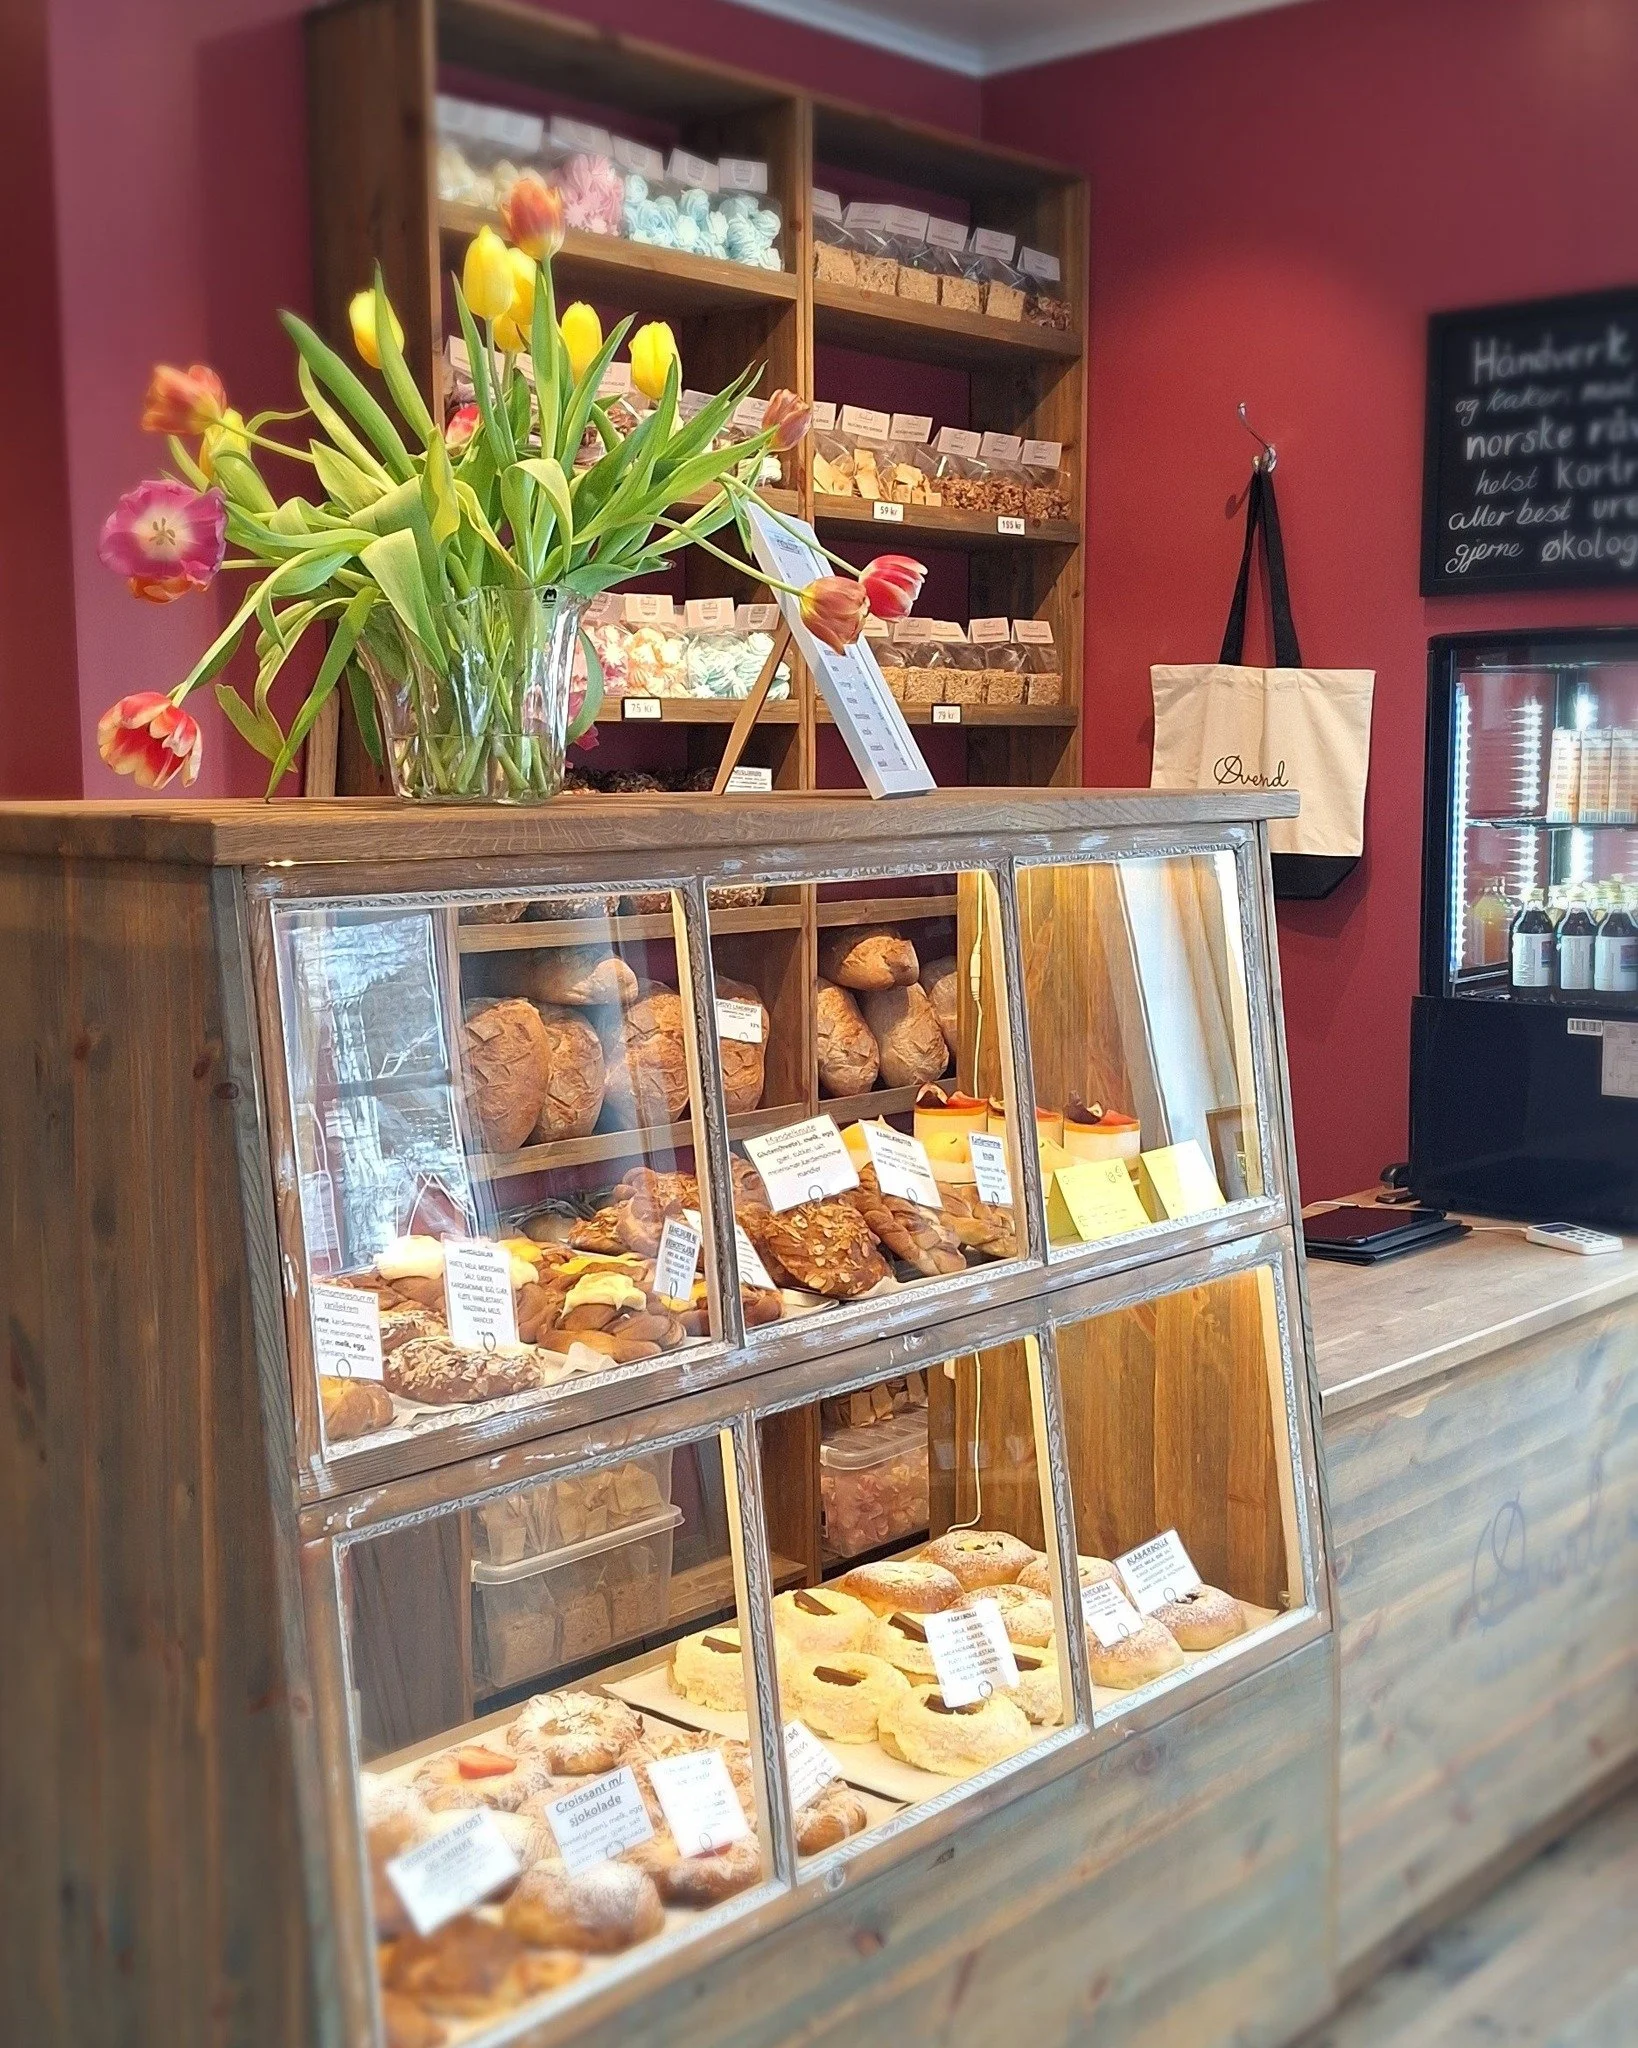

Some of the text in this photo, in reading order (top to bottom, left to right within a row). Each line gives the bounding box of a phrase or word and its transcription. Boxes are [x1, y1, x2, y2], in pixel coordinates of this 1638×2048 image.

[1455, 398, 1480, 427] og
[1466, 415, 1574, 460] norske
[1475, 466, 1538, 495] helst
[880, 506, 889, 514] 59
[1516, 497, 1573, 525] best
[1445, 539, 1524, 573] gjerne
[1213, 755, 1289, 787] Øvend
[556, 1772, 624, 1814] Croissant m/
